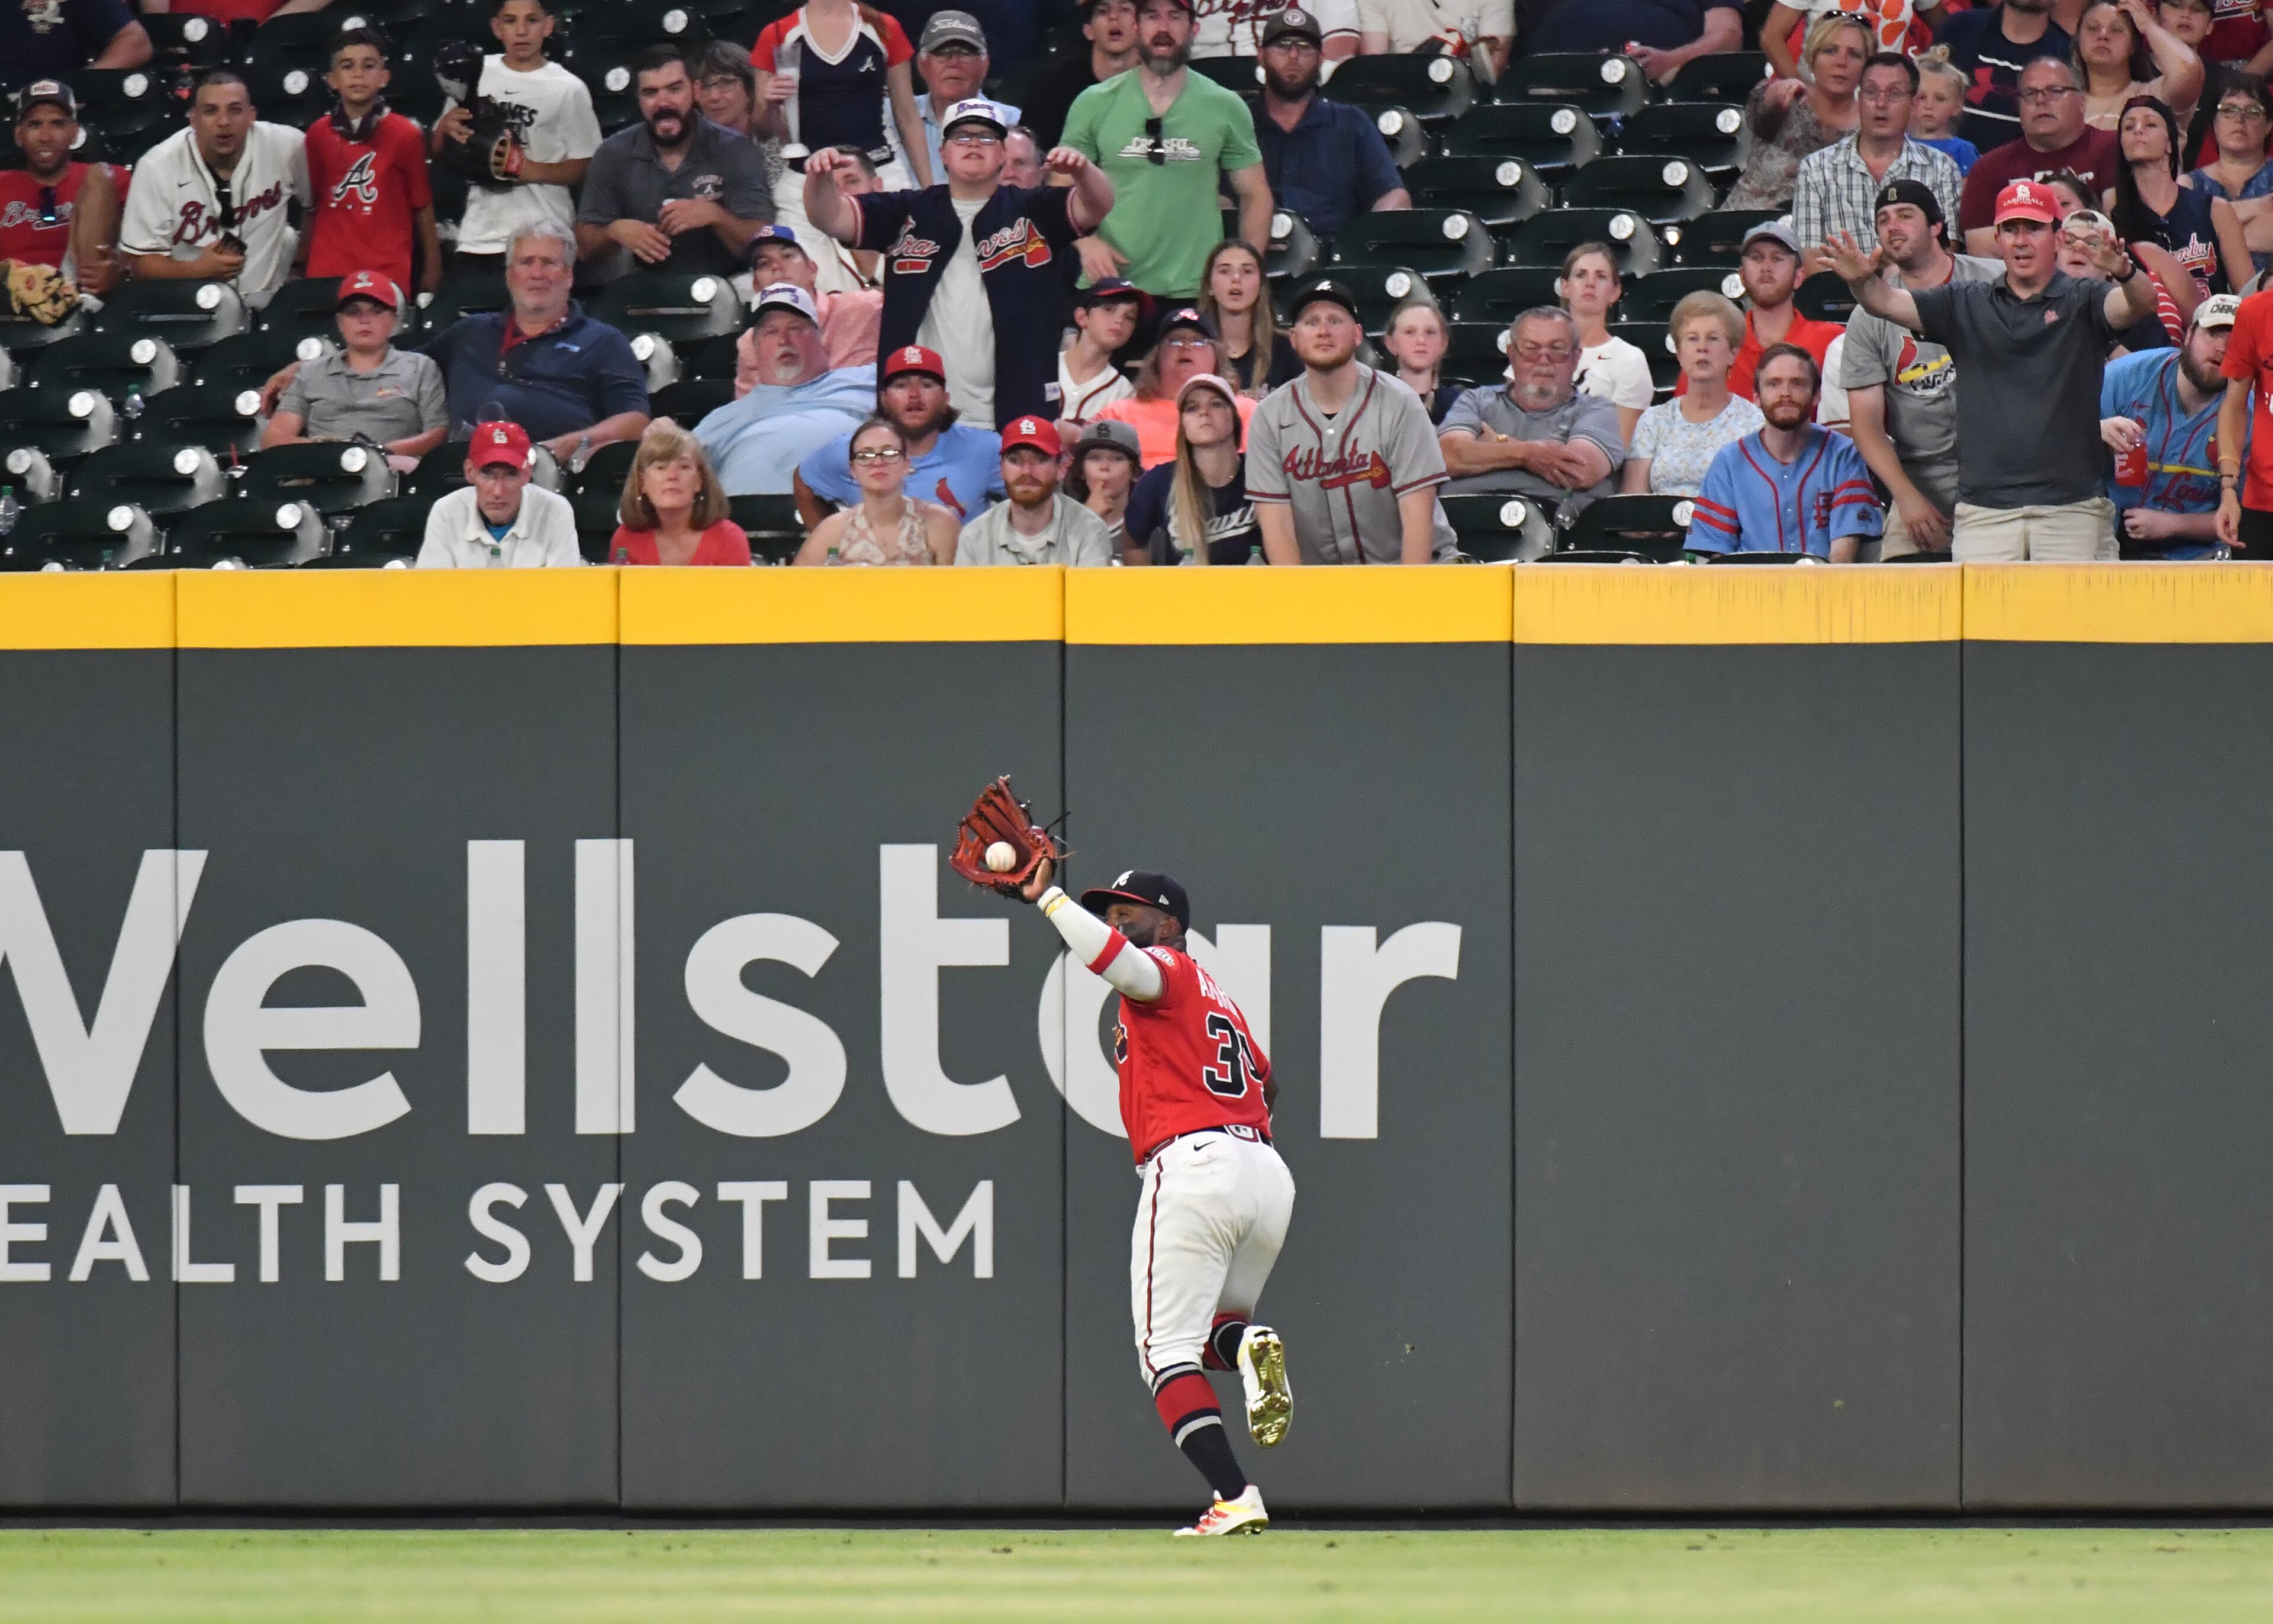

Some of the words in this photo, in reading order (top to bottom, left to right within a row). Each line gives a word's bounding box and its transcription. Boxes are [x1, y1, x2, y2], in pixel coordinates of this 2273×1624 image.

[333, 151, 378, 203] A
[2003, 198, 2043, 207] CARDINALS
[1283, 437, 1369, 481] Atlanta
[464, 1180, 994, 1283] SYSTEM
